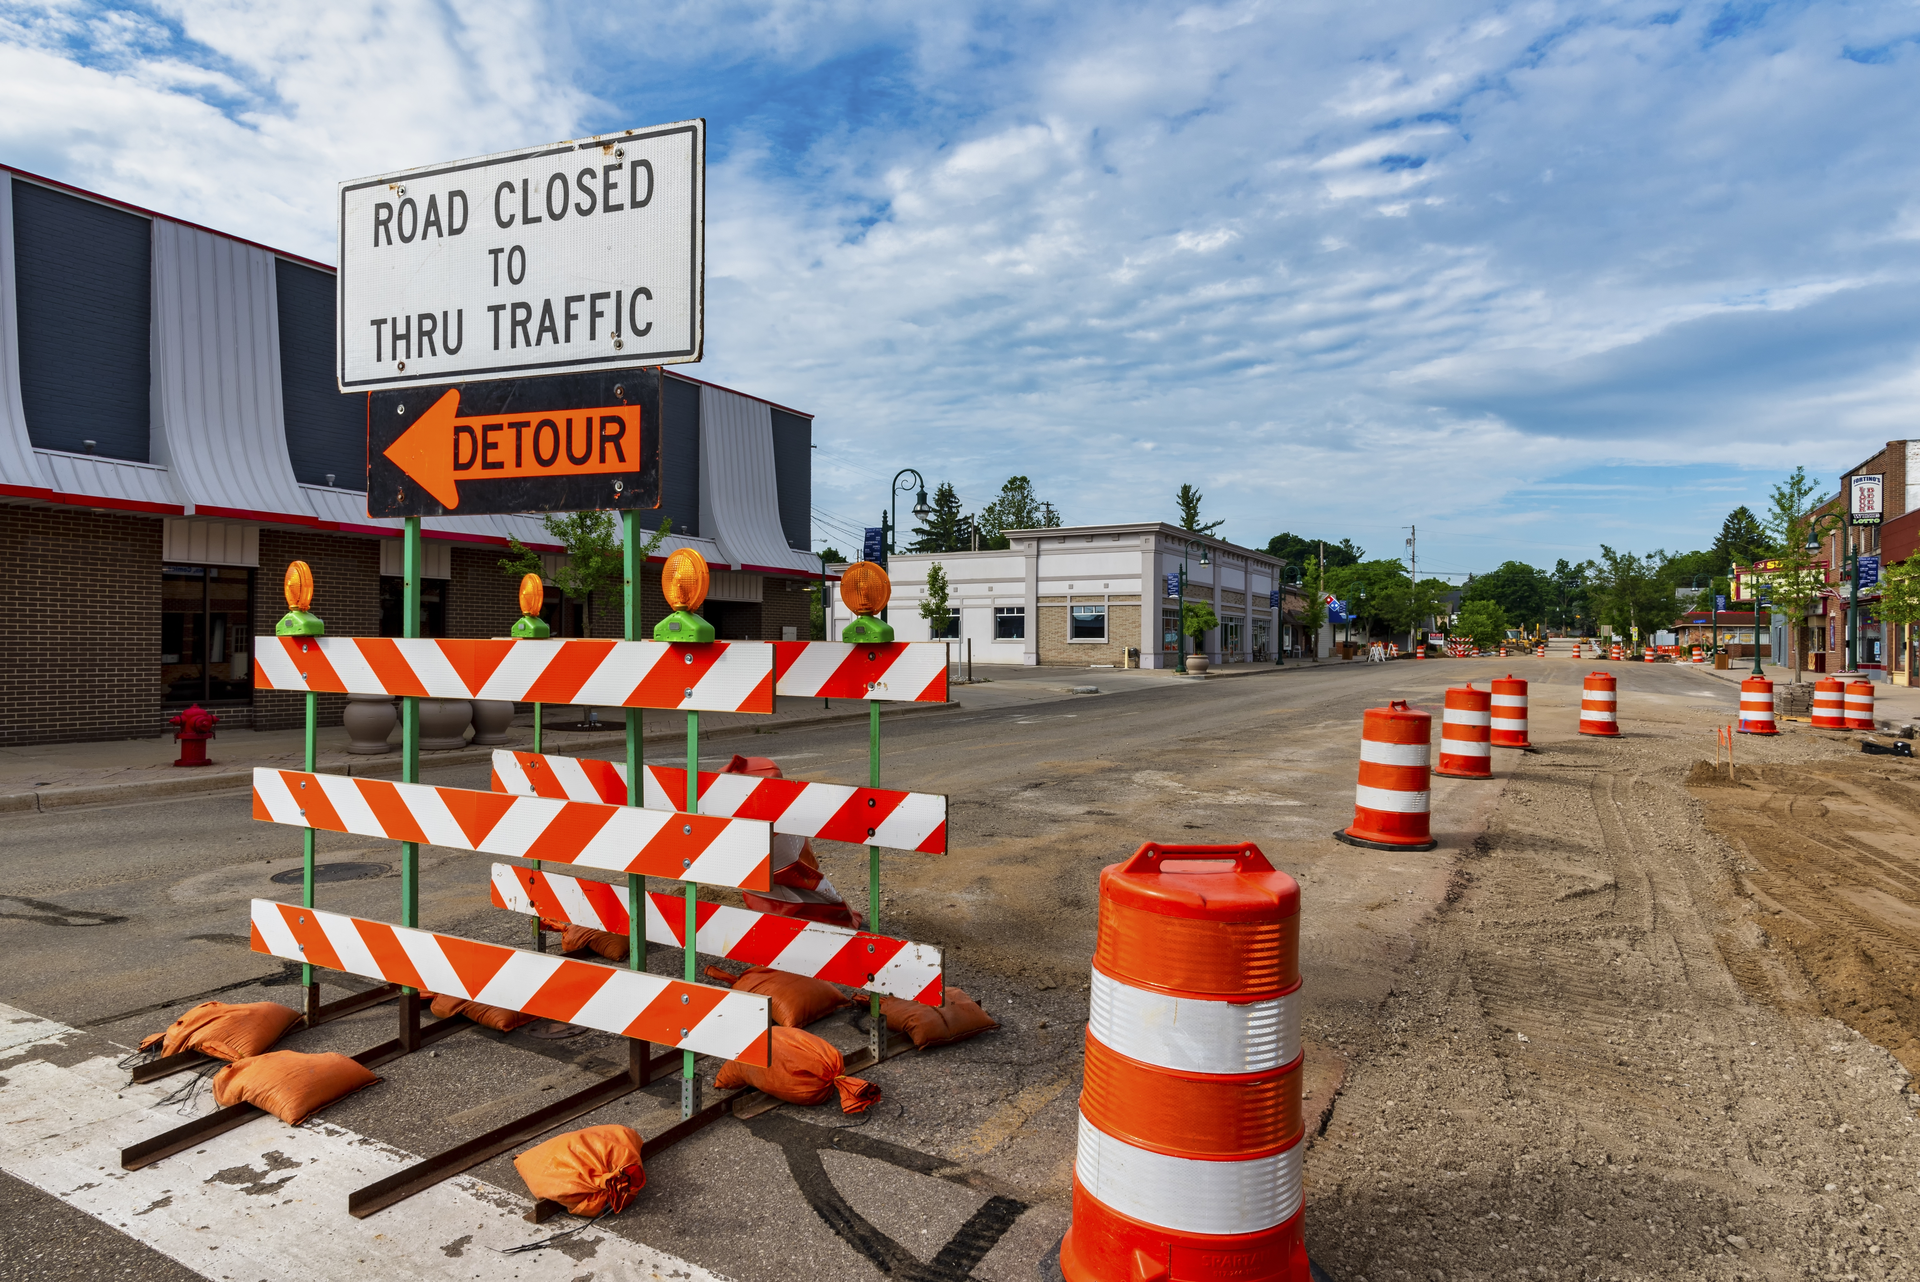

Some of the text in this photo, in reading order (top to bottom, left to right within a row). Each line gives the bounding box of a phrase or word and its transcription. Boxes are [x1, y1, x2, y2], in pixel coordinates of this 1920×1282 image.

[374, 159, 654, 247] ROAD CLOSED
[488, 245, 526, 287] TO
[370, 286, 653, 363] THRU TRAFFIC
[453, 415, 627, 472] DETOUR
[1853, 476, 1881, 484] FORTINO'S
[1867, 487, 1875, 511] BEER
